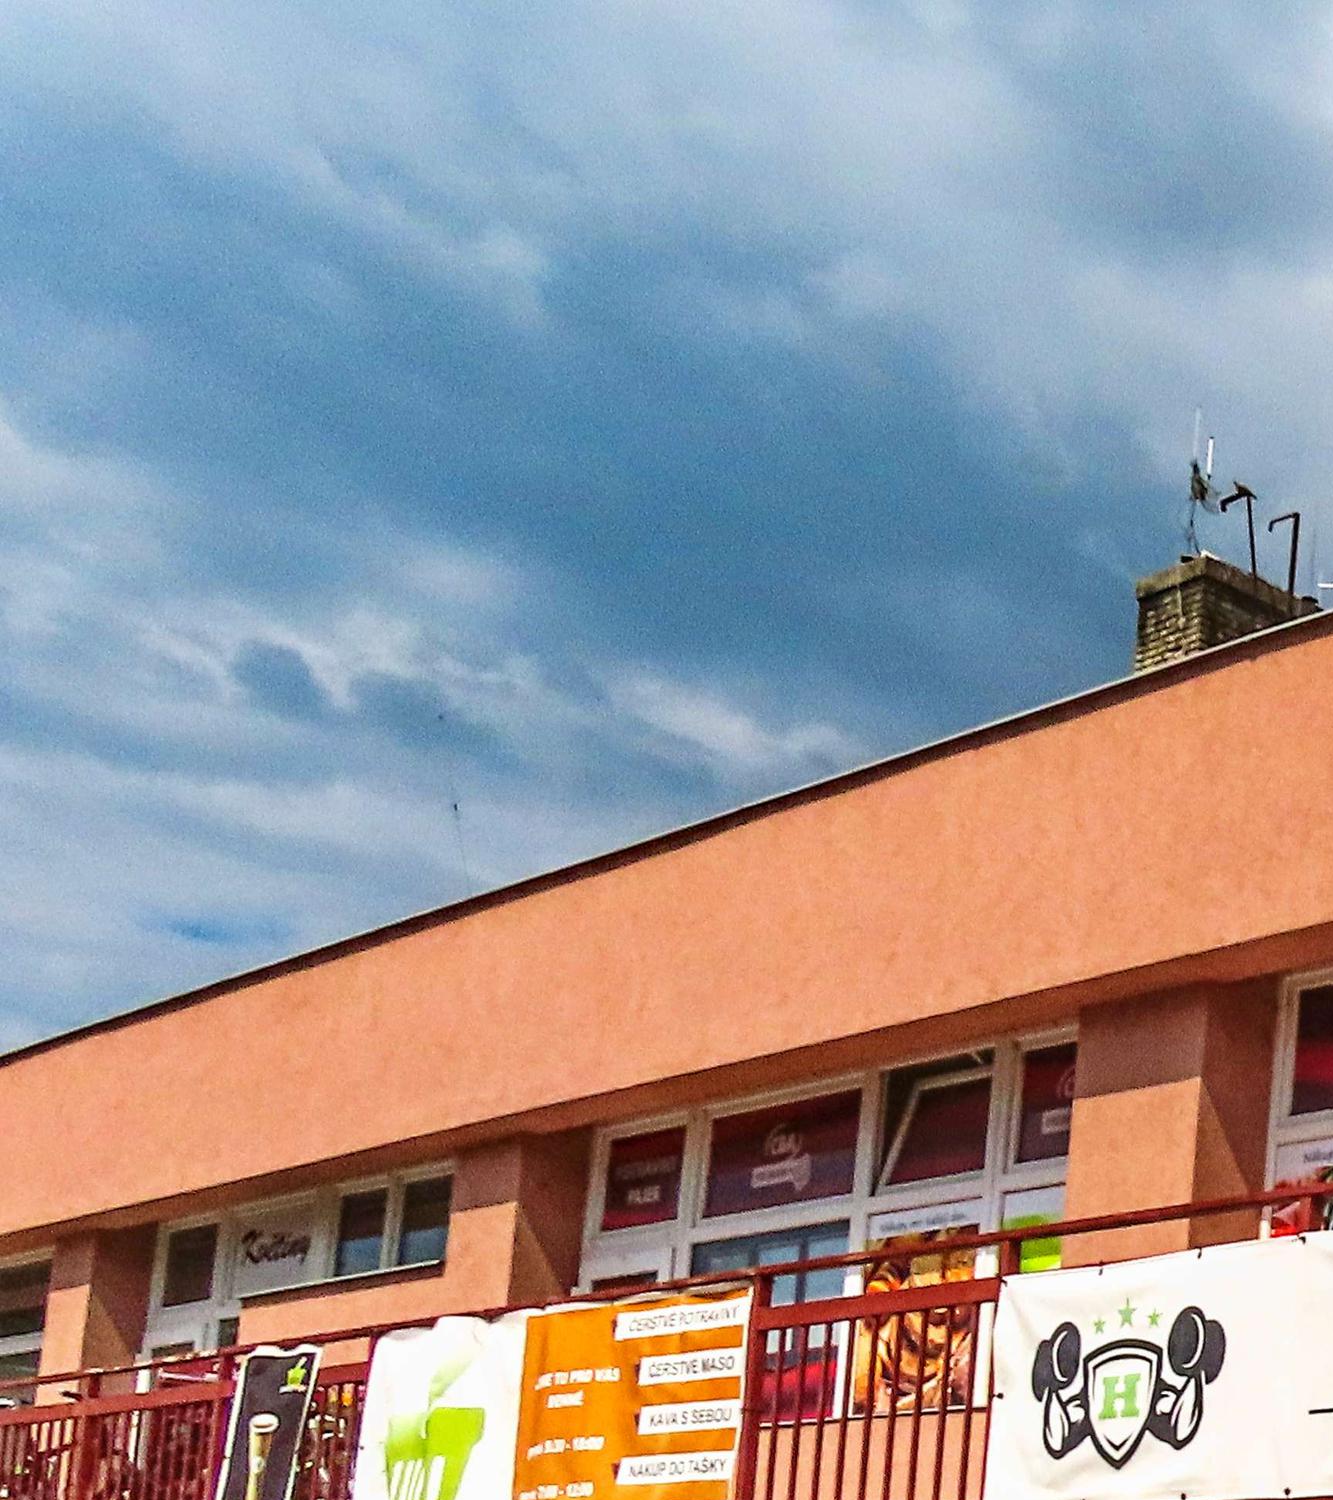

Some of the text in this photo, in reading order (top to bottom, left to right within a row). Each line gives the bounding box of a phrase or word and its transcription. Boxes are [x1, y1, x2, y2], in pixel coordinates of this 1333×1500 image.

[1098, 1373, 1141, 1419] H
[681, 1410, 689, 1425] S
[690, 1407, 732, 1424] SEBOU
[668, 1460, 685, 1475] DO
